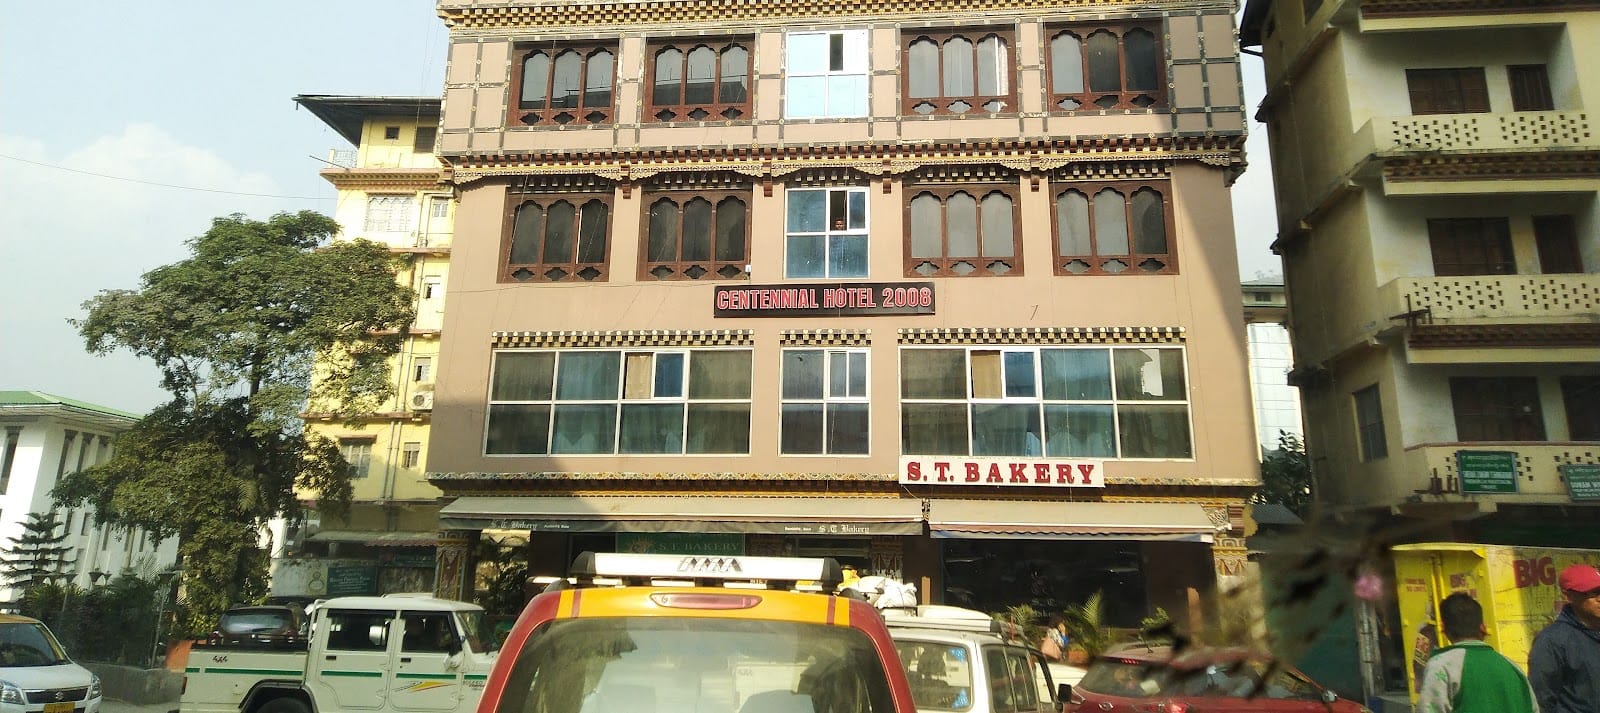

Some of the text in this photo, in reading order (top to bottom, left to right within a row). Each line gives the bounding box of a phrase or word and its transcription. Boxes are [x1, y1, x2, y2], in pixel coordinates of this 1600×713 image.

[717, 287, 932, 310] CENTENNIAL HOTEL 2008
[964, 463, 1095, 485] BAKERY
[841, 523, 870, 534] Bakery
[684, 542, 740, 552] BAKERY
[1512, 556, 1556, 588] BIG
